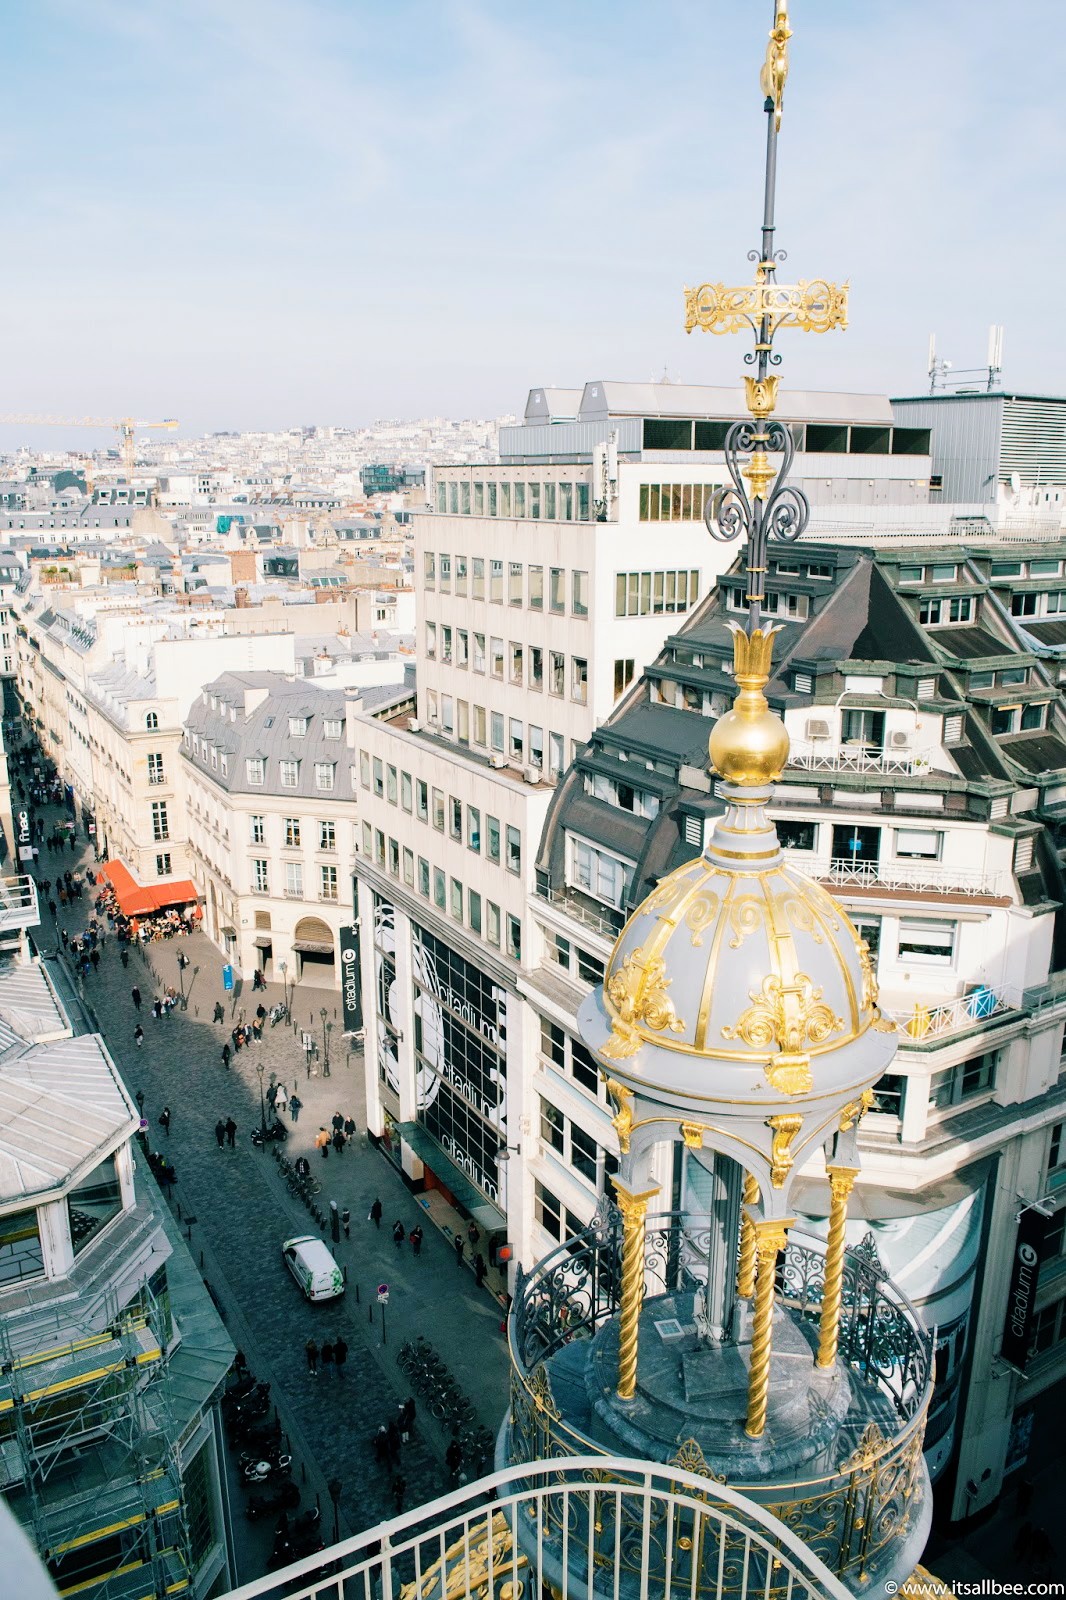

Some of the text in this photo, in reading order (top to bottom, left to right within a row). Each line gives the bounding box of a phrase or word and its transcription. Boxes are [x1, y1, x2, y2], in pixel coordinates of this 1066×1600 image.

[18, 811, 30, 842] fnac
[344, 963, 356, 1011] citadium
[438, 985, 497, 1045] citadium
[442, 1134, 498, 1203] citadium
[1012, 1267, 1032, 1338] citadium
